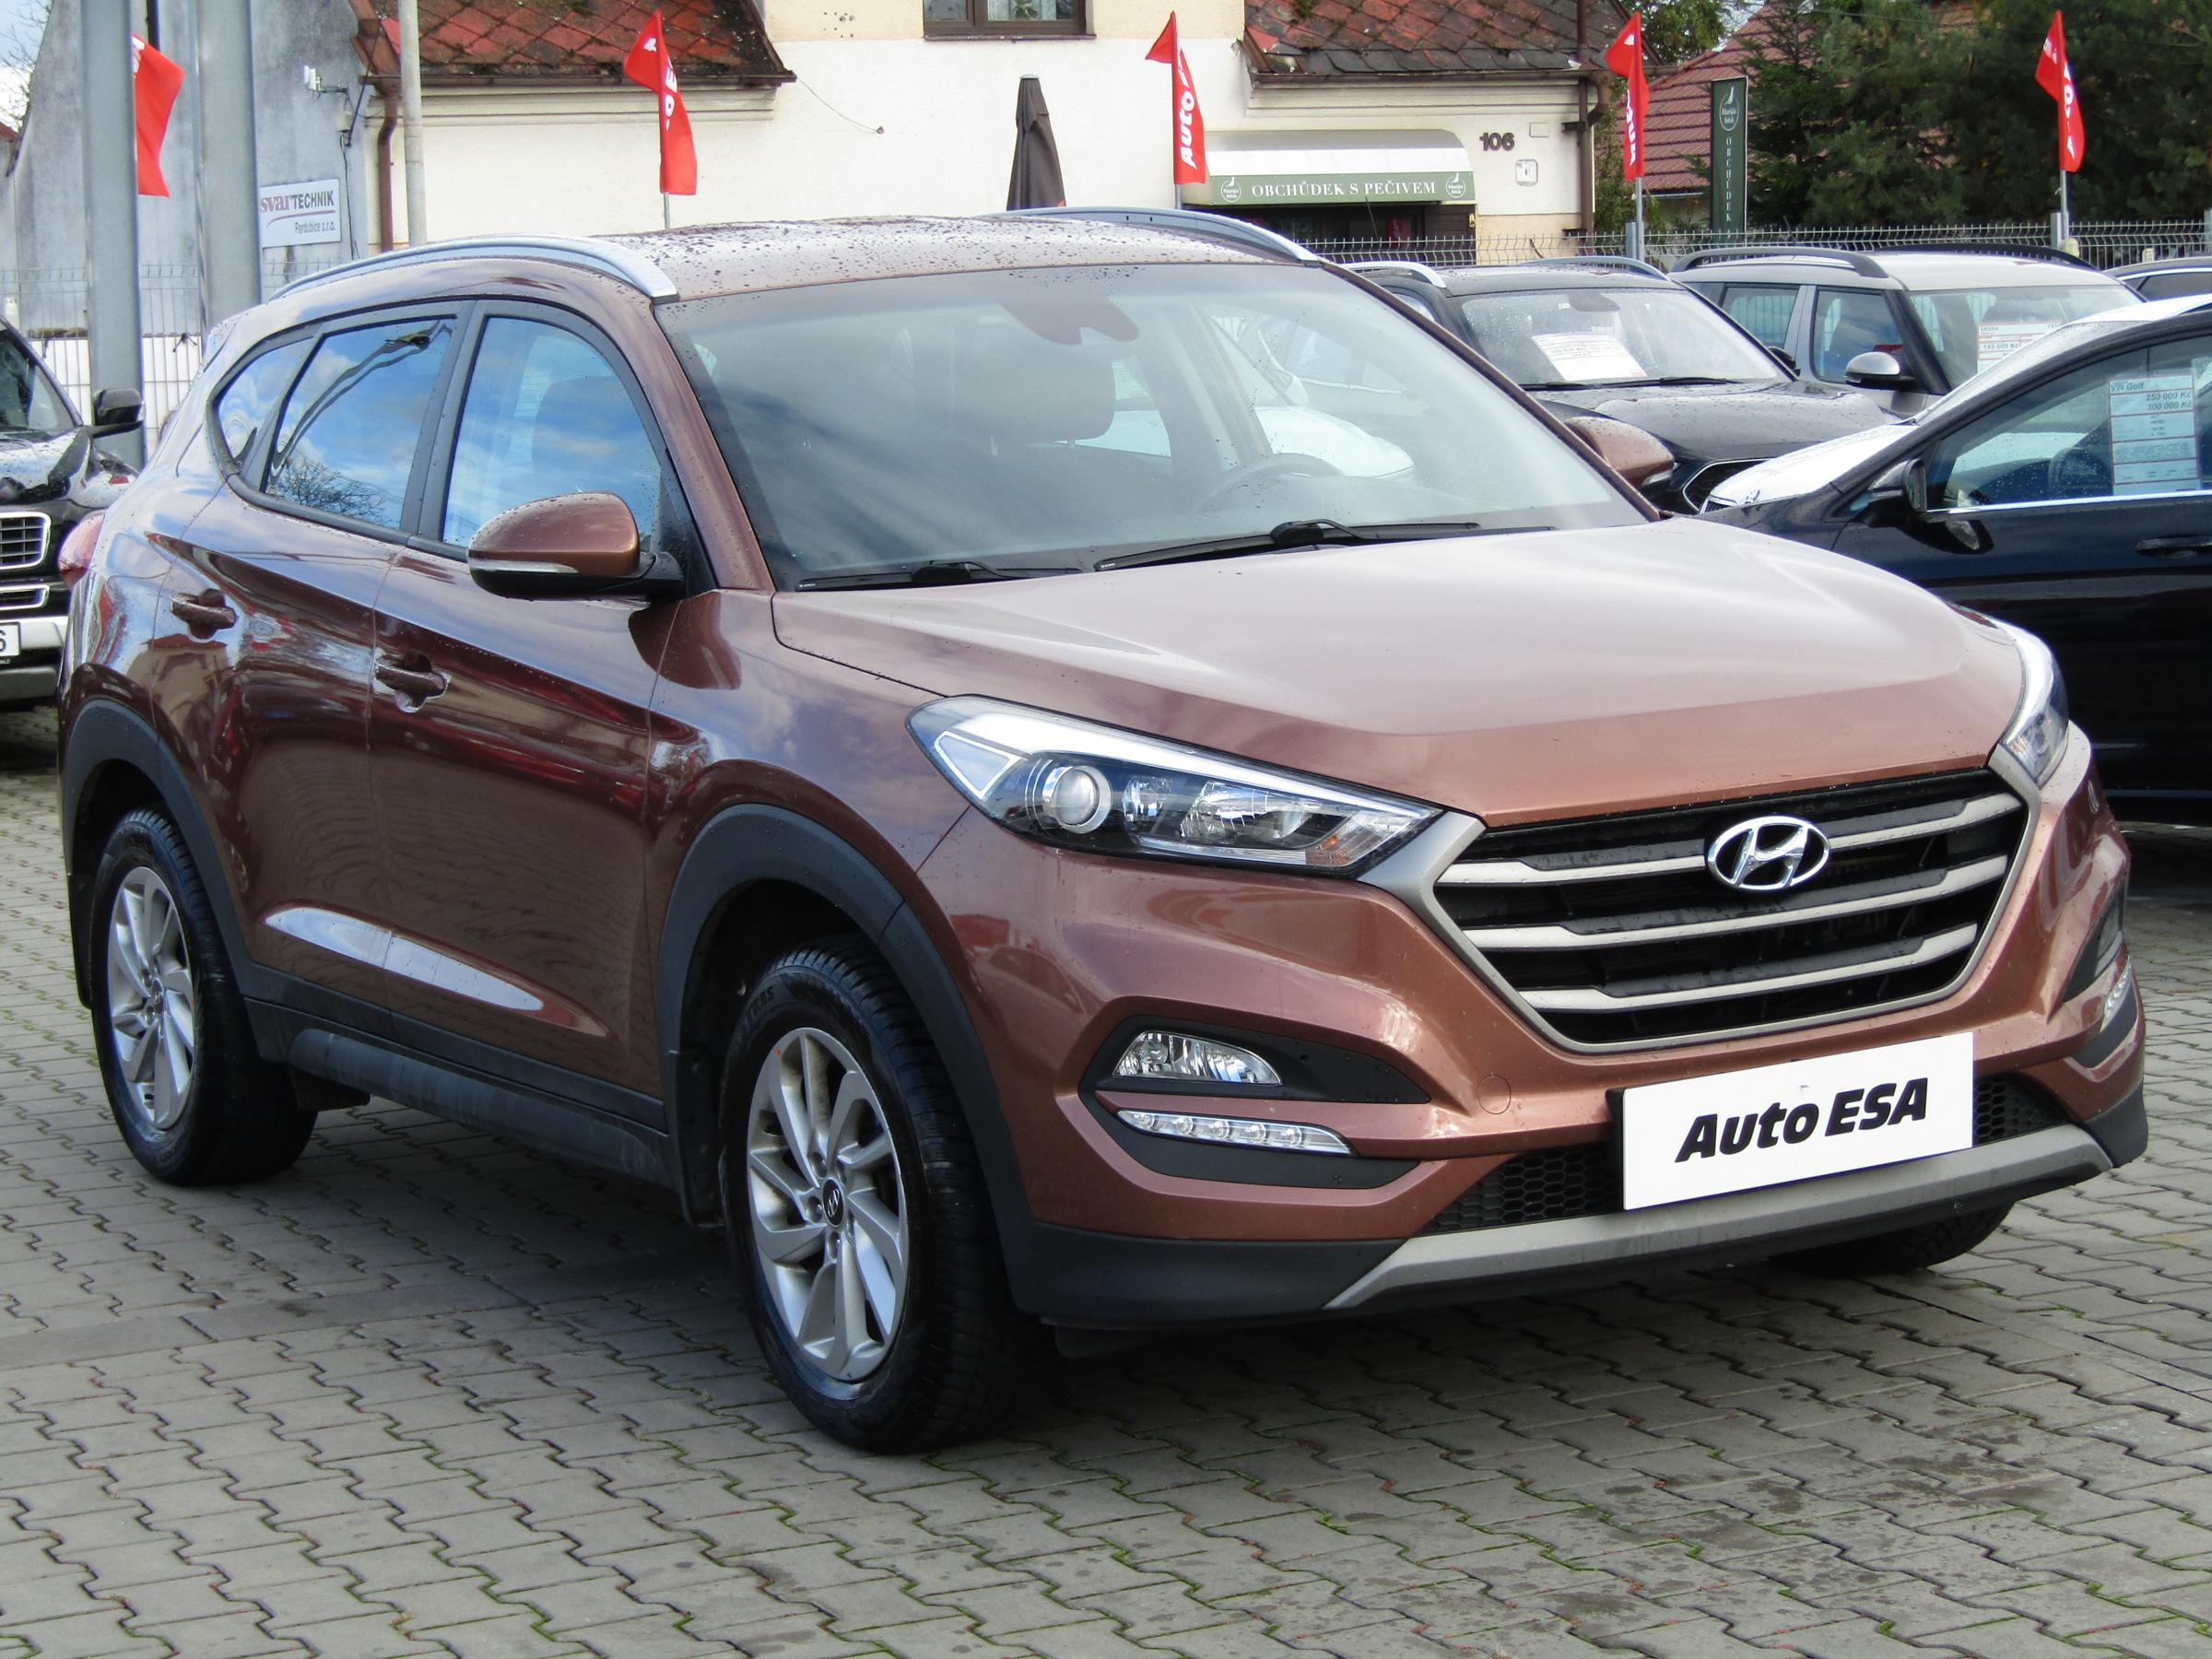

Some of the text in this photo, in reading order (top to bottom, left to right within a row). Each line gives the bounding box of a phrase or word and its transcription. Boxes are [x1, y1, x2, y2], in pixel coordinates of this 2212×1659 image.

[1478, 132, 1515, 151] 106
[1252, 180, 1345, 197] OBCHŮDEK
[1349, 182, 1359, 195] S
[1365, 179, 1436, 195] PEČIVEM
[2110, 382, 2145, 392] VW Golf
[1675, 1077, 1928, 1162] Auto ESA
